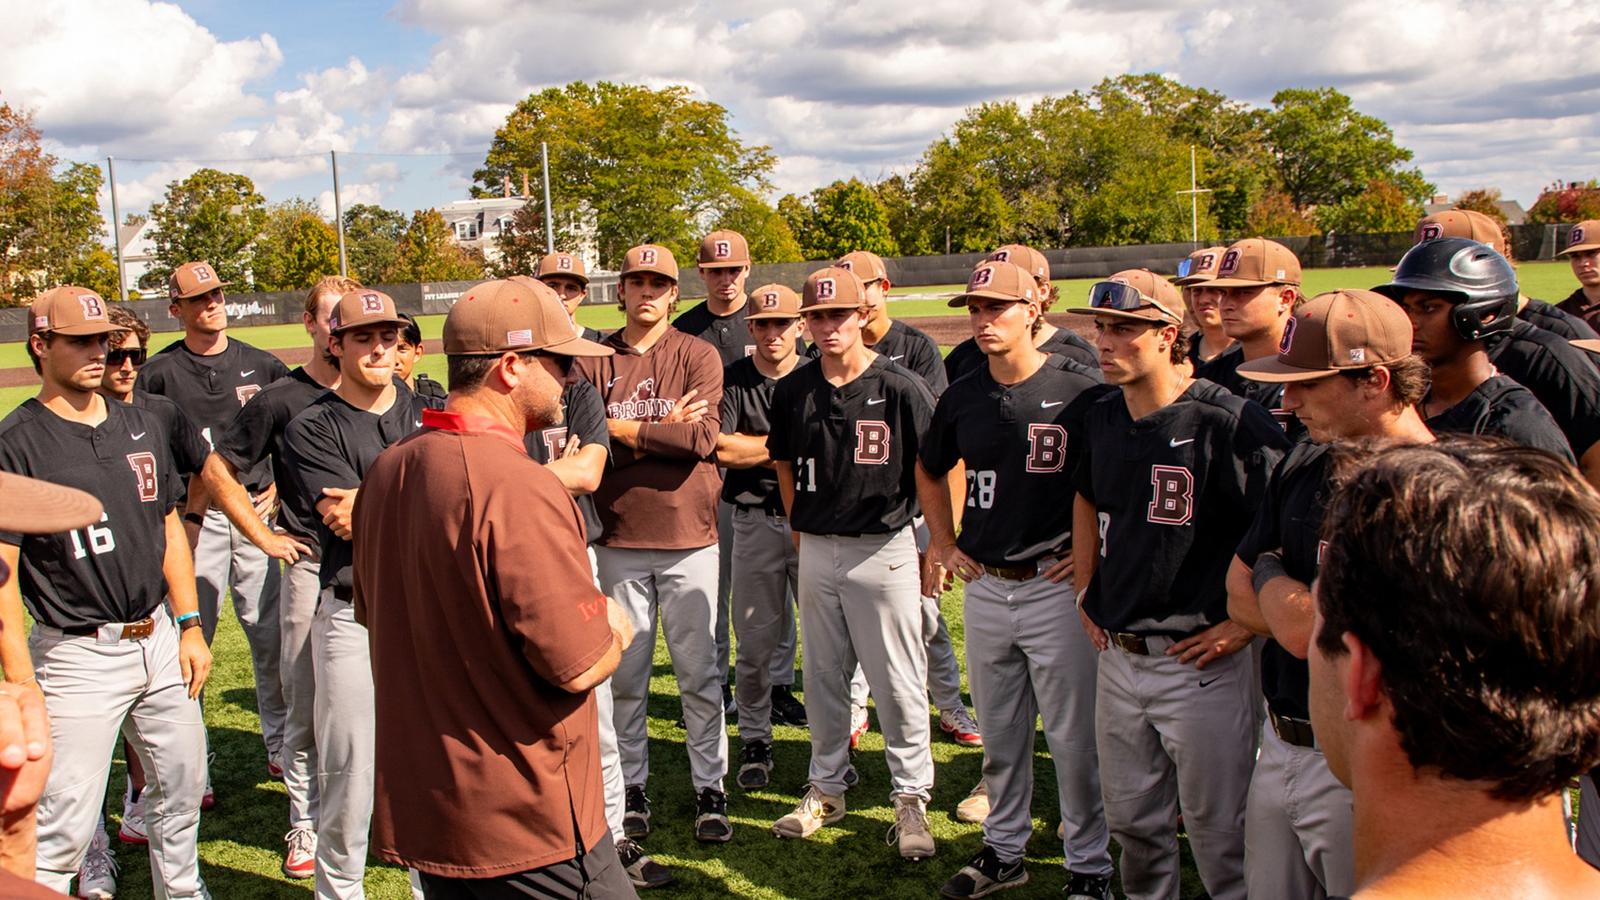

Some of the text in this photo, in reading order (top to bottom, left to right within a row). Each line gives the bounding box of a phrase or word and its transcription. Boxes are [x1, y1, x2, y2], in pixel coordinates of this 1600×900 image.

[1570, 227, 1584, 244] B
[640, 249, 657, 266] B
[715, 240, 730, 257] B
[557, 255, 572, 271] B
[1198, 253, 1216, 271] B
[1220, 248, 1241, 275] B
[194, 266, 211, 282] B
[974, 267, 994, 287] B
[817, 278, 836, 299] B
[80, 296, 103, 319] B
[361, 293, 384, 314] B
[763, 292, 779, 309] B
[608, 398, 676, 419] BROWN
[855, 420, 890, 464] B
[1026, 423, 1067, 473] B
[127, 452, 157, 502] B
[966, 469, 996, 509] 28
[1147, 464, 1194, 525] B
[69, 511, 116, 560] 16
